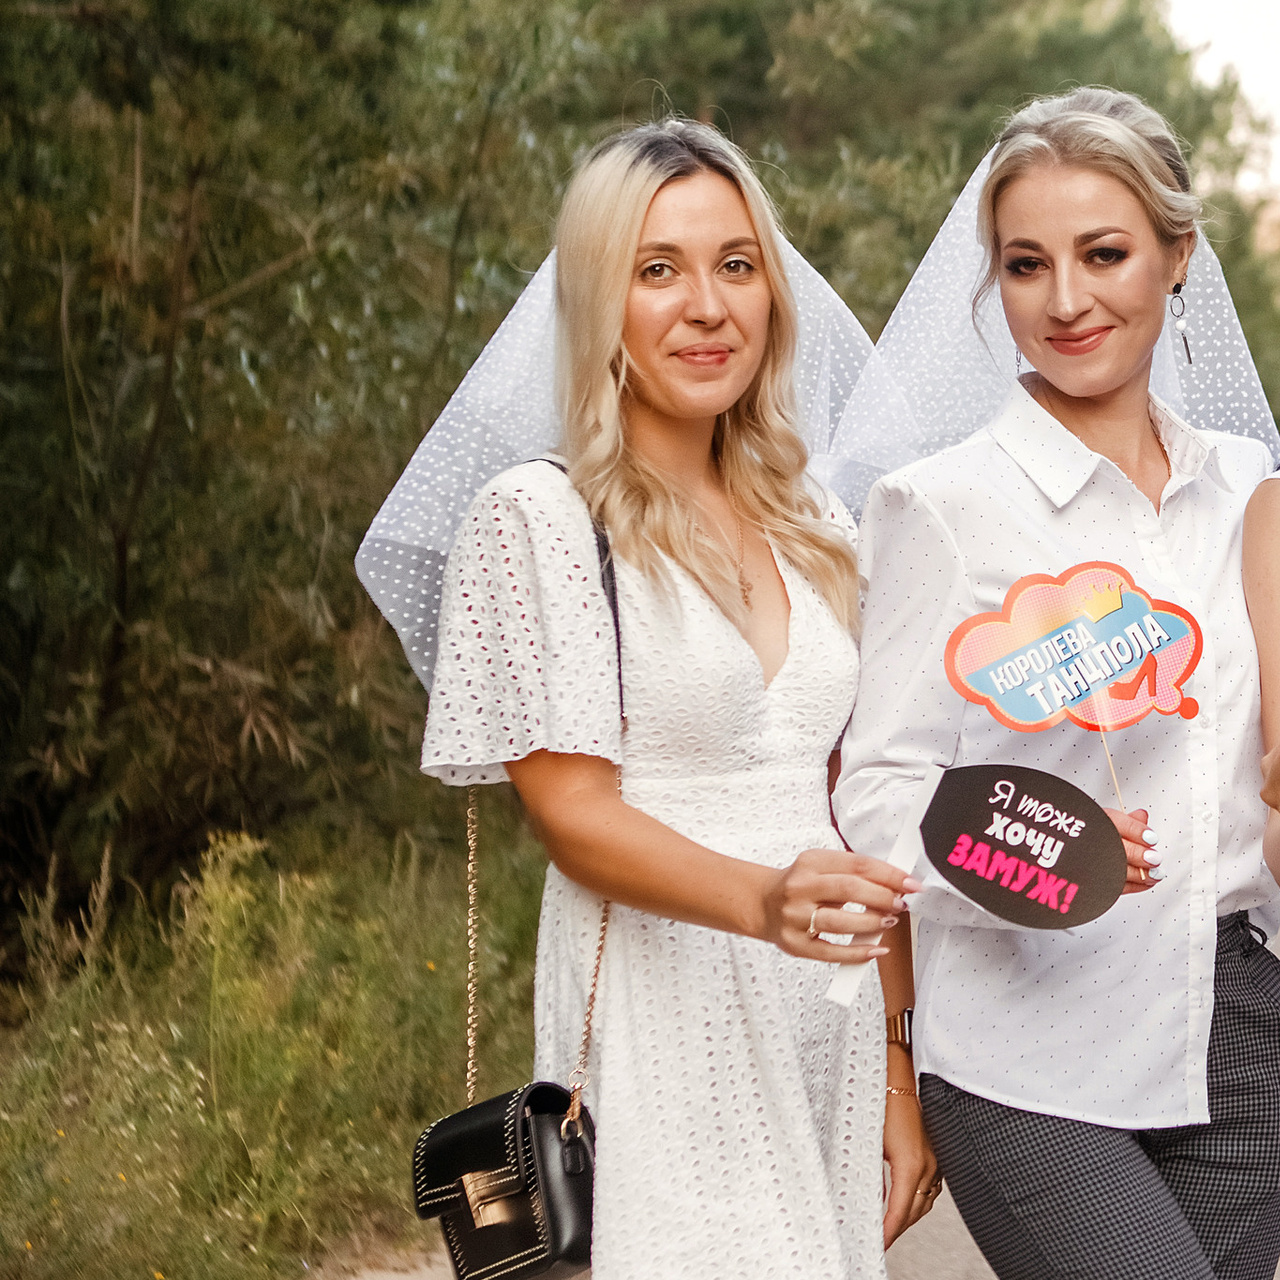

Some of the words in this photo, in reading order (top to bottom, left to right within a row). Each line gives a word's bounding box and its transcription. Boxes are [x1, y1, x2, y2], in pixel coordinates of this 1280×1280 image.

[988, 622, 1098, 695] КОРОЛЕВА
[1025, 613, 1172, 715] ТАНЦПОЛА
[988, 780, 1016, 810] Я
[946, 833, 1079, 914] ЗАМУЖ!
